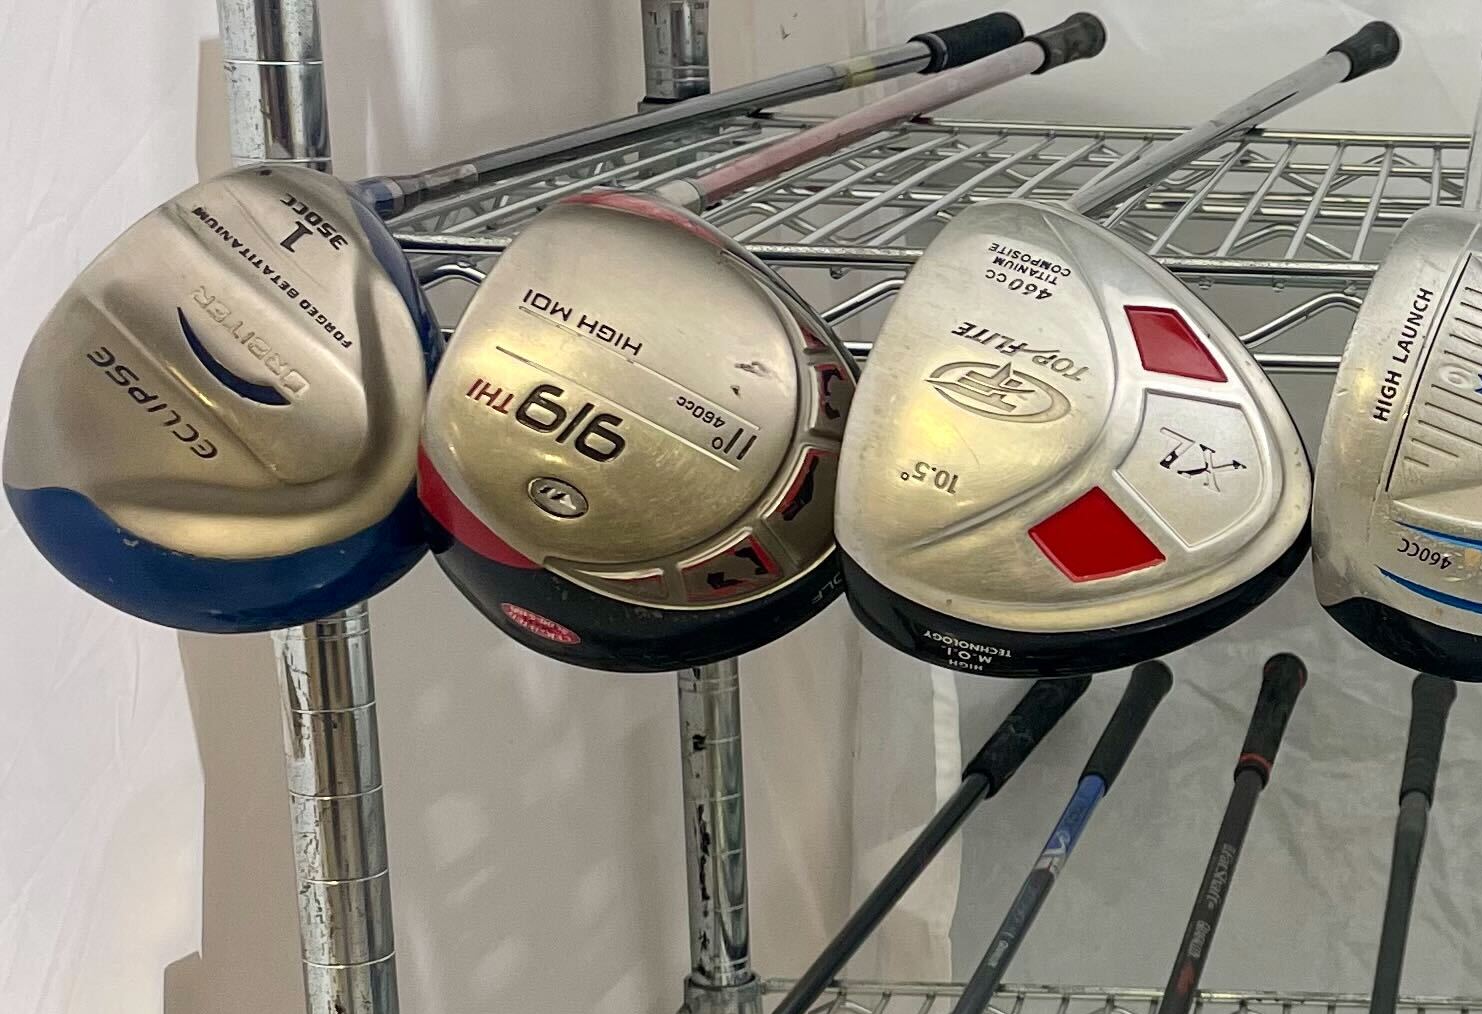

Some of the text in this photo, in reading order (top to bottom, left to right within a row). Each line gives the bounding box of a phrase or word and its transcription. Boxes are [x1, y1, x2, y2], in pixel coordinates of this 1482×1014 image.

[280, 221, 314, 253] 1
[989, 241, 1072, 278] COMPOSITE
[992, 255, 1059, 286] TITANIUM
[300, 299, 353, 349] FORGED
[523, 289, 643, 355] HIGH MOI
[1373, 288, 1434, 423] HIGH LAUNCH
[87, 346, 218, 460] ECLIPSE
[465, 377, 514, 415] THI
[924, 630, 1012, 658] TECHNOLOGY
[948, 659, 984, 673] HIGH
